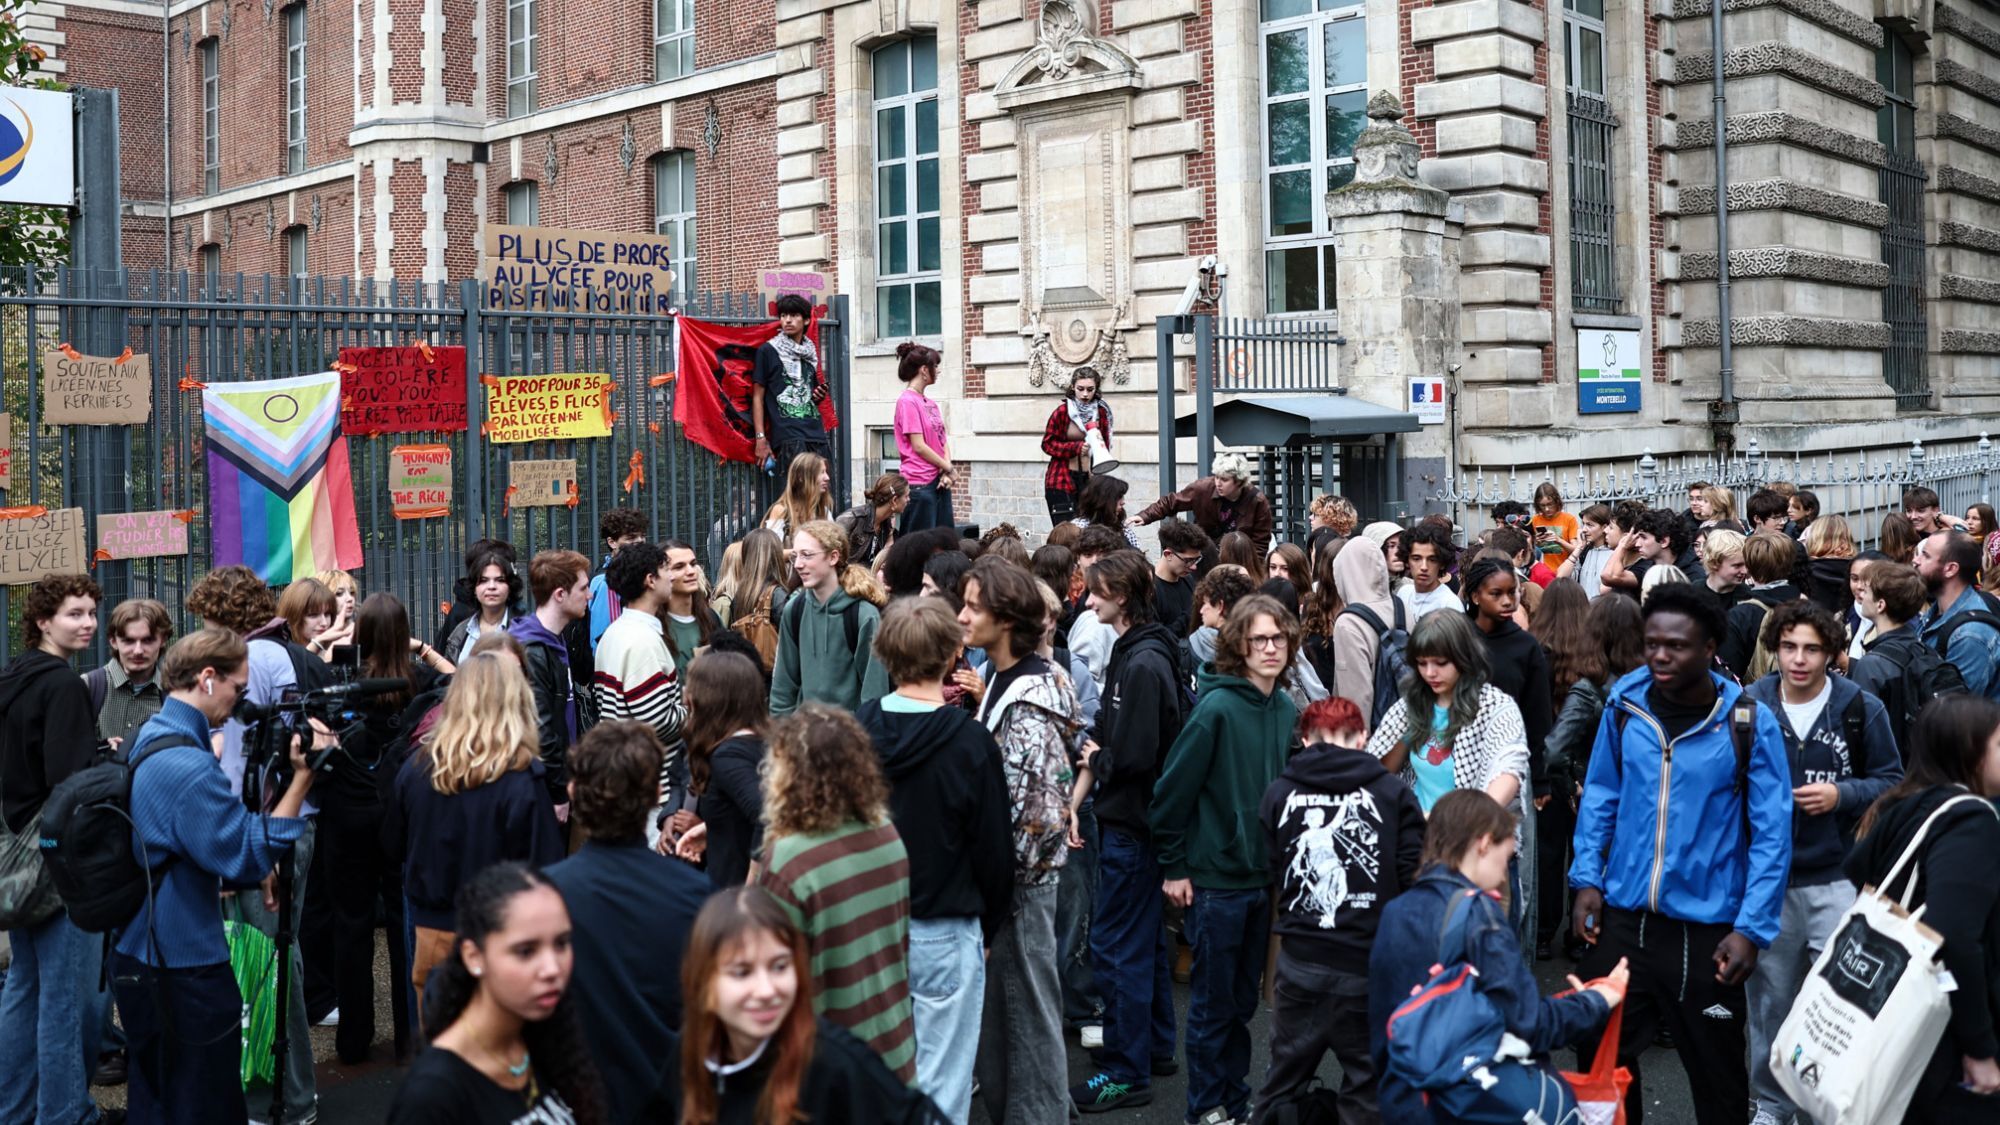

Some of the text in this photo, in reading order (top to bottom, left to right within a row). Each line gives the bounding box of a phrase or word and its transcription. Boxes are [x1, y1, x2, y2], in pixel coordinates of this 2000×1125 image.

[499, 234, 670, 271] PLUS DE PROFS
[495, 266, 523, 286] AU
[604, 269, 654, 292] POUR
[57, 358, 139, 379] SOUTIEN AUX
[506, 379, 547, 395] PROF
[548, 378, 581, 391] POUR
[584, 377, 600, 390] 36
[489, 395, 549, 414] ÉLÈVES,
[565, 394, 600, 408] FLICS
[1596, 395, 1627, 404] MONTEBELLO
[397, 404, 423, 424] PAS
[492, 415, 519, 429] PAR
[403, 452, 450, 465] HUNGRY?
[393, 491, 414, 504] THE
[116, 514, 137, 528] ON
[18, 546, 71, 573] LYCÉE
[1278, 787, 1383, 829] METALLICA
[1842, 949, 1870, 977] FAIR
